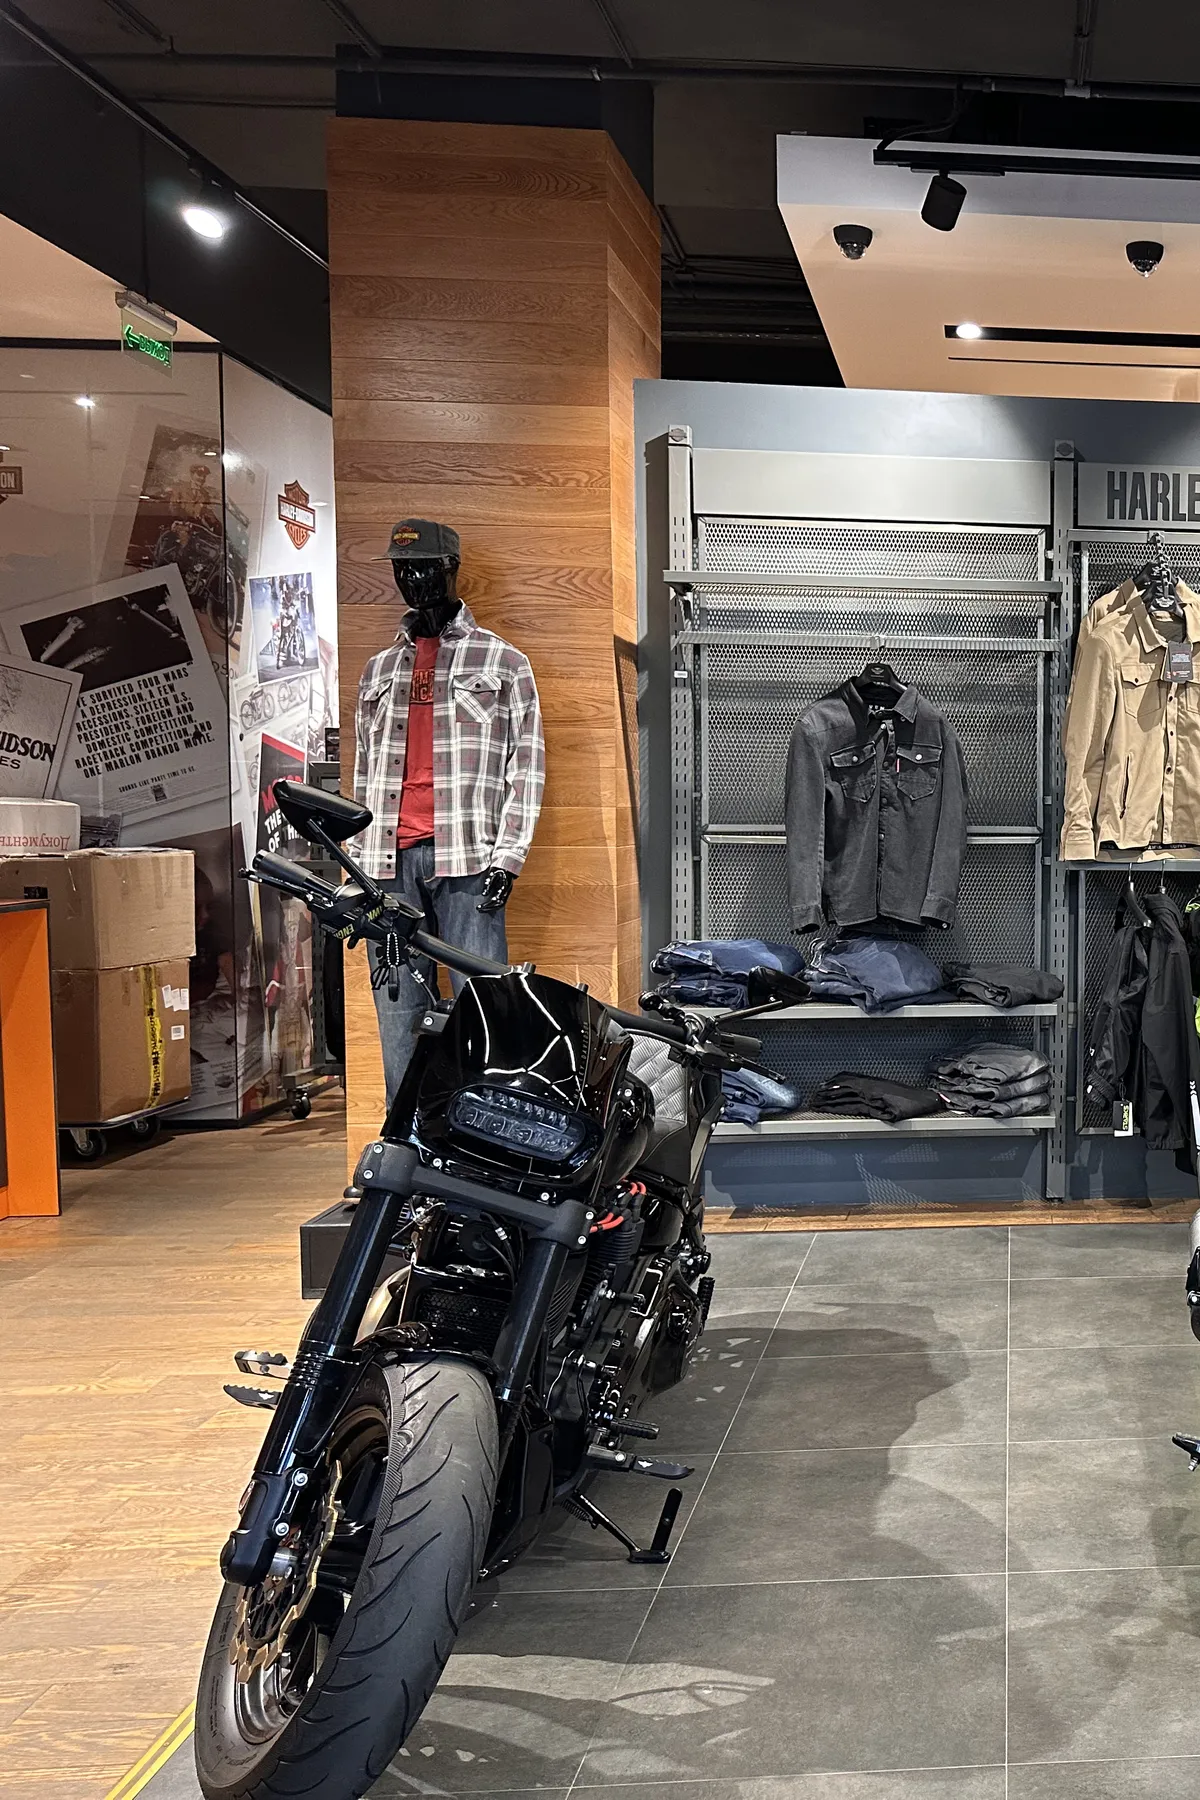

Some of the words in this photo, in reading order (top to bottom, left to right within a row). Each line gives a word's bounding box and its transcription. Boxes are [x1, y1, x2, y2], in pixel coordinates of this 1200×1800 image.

[90, 683, 134, 704] SURVIVED
[137, 676, 161, 691] FOUR
[163, 667, 189, 682] WARS
[80, 709, 87, 719] A
[148, 689, 155, 699] A
[157, 682, 176, 697] FEW
[133, 697, 170, 716] SIXTEEN
[135, 708, 173, 727] FOREIGN
[176, 701, 194, 716] AND
[0, 731, 56, 764] IDSON
[75, 746, 126, 769] RACETRACK
[86, 732, 131, 754] DOMESTIC
[83, 765, 101, 779] ONE
[104, 753, 141, 772] MARLON
[144, 742, 180, 760] BRANDO
